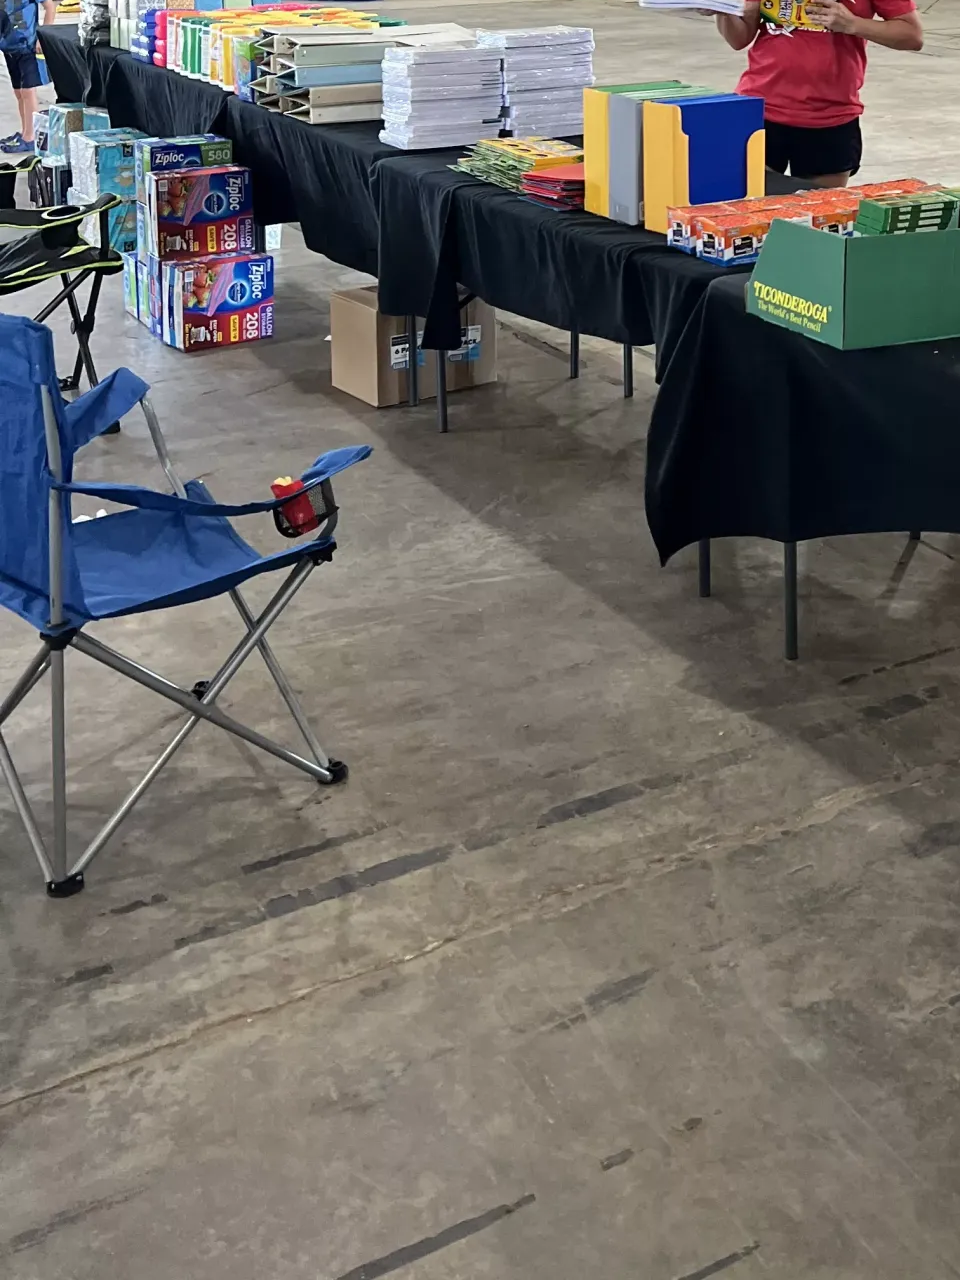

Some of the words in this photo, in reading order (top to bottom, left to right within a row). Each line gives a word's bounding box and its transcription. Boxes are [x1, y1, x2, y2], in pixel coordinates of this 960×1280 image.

[155, 152, 185, 166] Ziploc
[201, 143, 232, 151] SANDWICH
[208, 149, 231, 161] 580
[225, 177, 242, 211] Ziploc
[223, 224, 237, 250] 208
[248, 264, 264, 299] Ziploc
[753, 280, 828, 324] TICONDEROGA
[246, 312, 258, 339] 208
[265, 306, 273, 336] GALLON
[758, 300, 768, 311] The
[768, 303, 790, 320] World's
[790, 312, 803, 326] Best
[803, 316, 822, 333] Pencil
